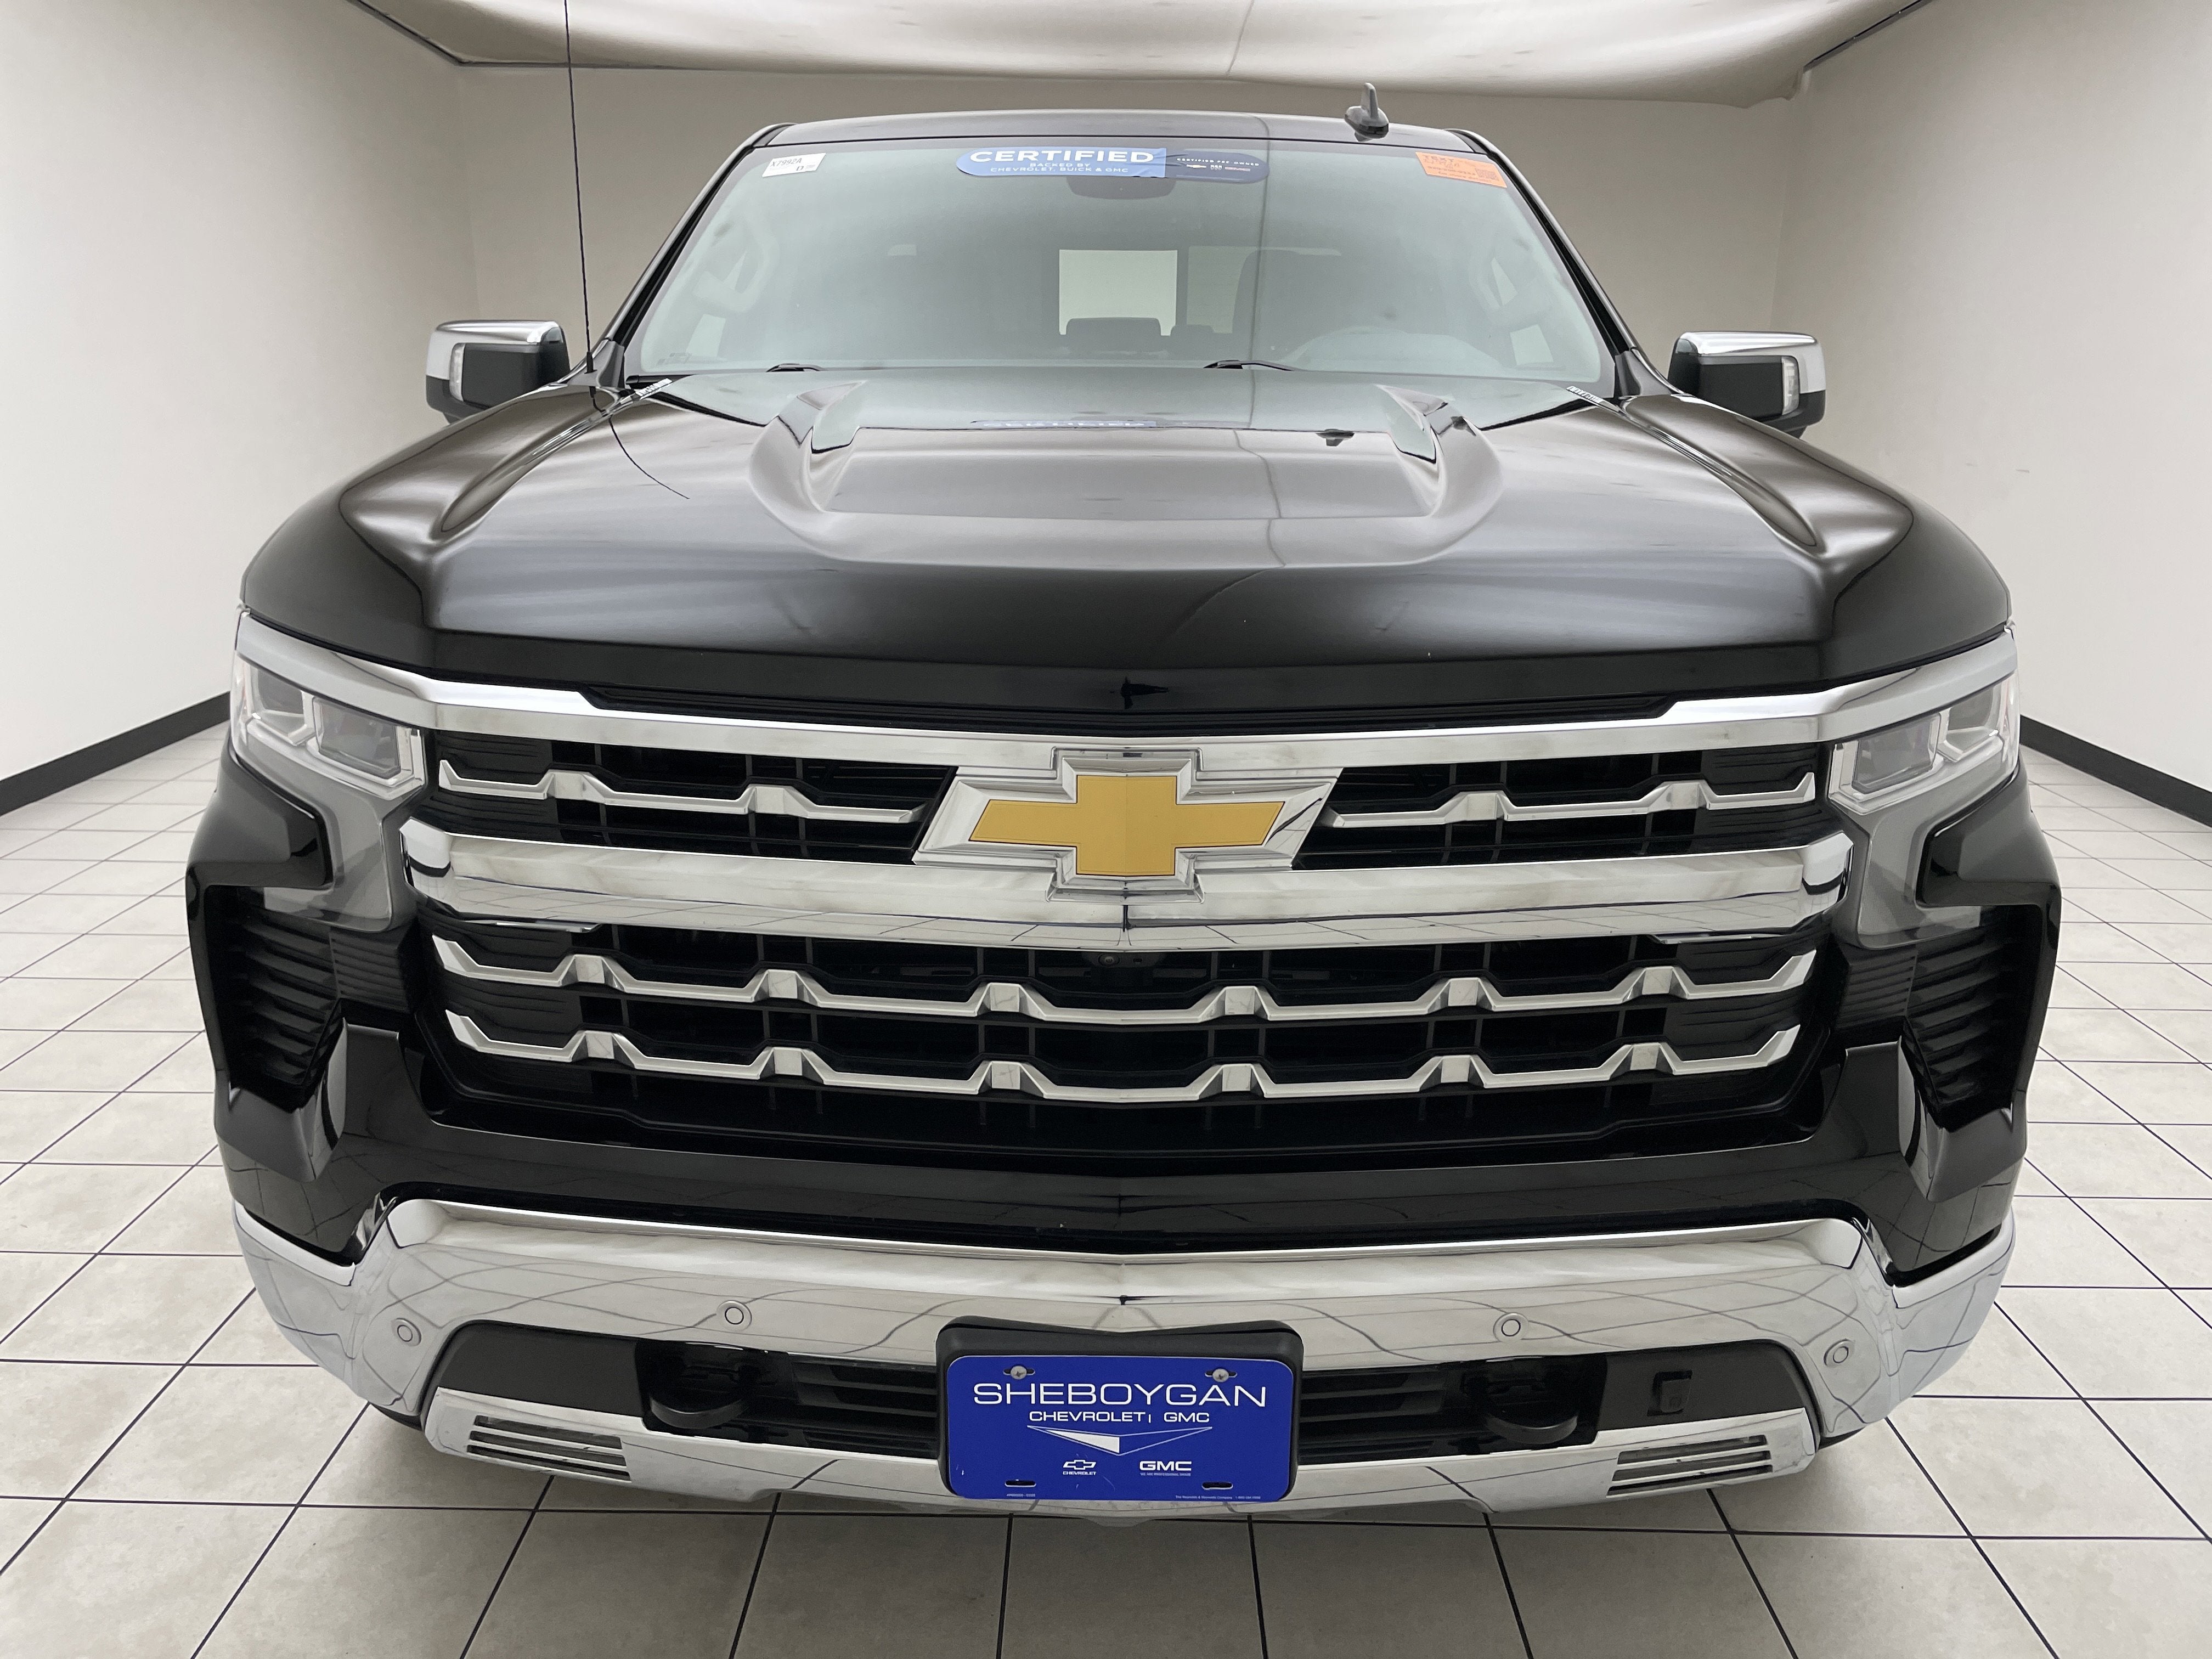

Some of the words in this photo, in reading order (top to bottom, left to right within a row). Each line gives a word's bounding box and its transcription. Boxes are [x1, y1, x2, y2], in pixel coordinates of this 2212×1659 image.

[970, 150, 1154, 163] CERTIFIED
[974, 1383, 1266, 1408] SHEBOYGAN
[1029, 1411, 1146, 1422] CHEVROLET
[1163, 1412, 1210, 1423] GMC
[1139, 1460, 1192, 1471] GMC
